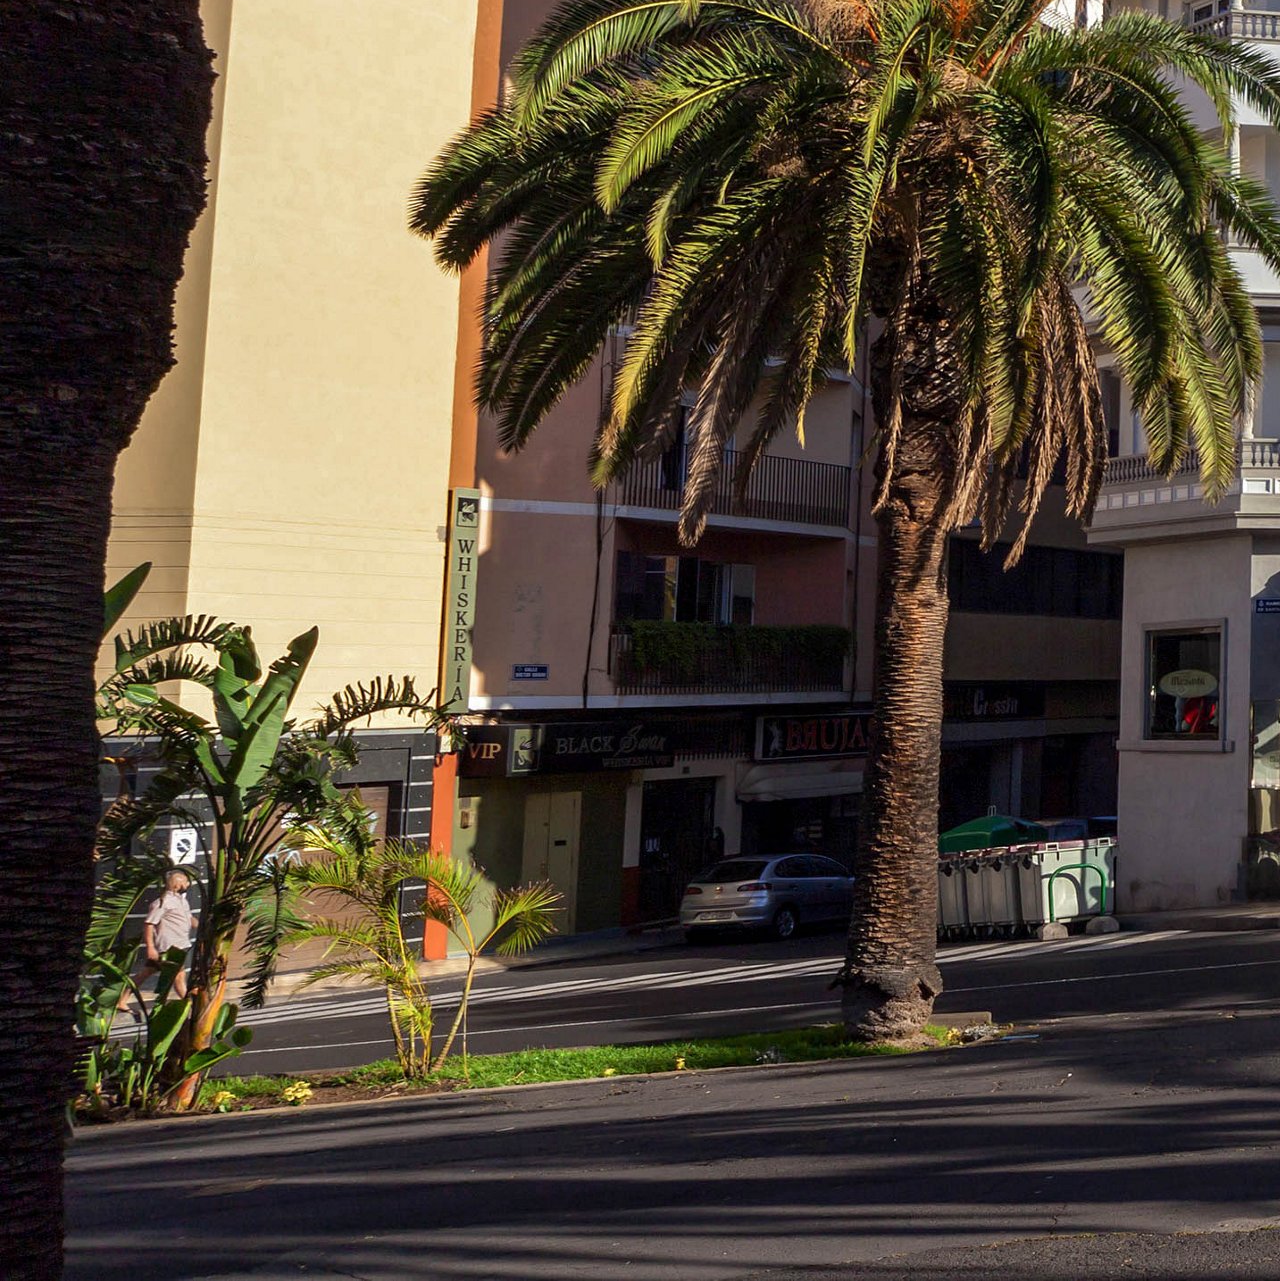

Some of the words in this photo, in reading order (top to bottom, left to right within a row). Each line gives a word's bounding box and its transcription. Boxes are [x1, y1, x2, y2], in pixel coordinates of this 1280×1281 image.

[453, 538, 475, 701] WHISKERÍA
[468, 742, 502, 760] VIP
[555, 735, 614, 755] BLACK
